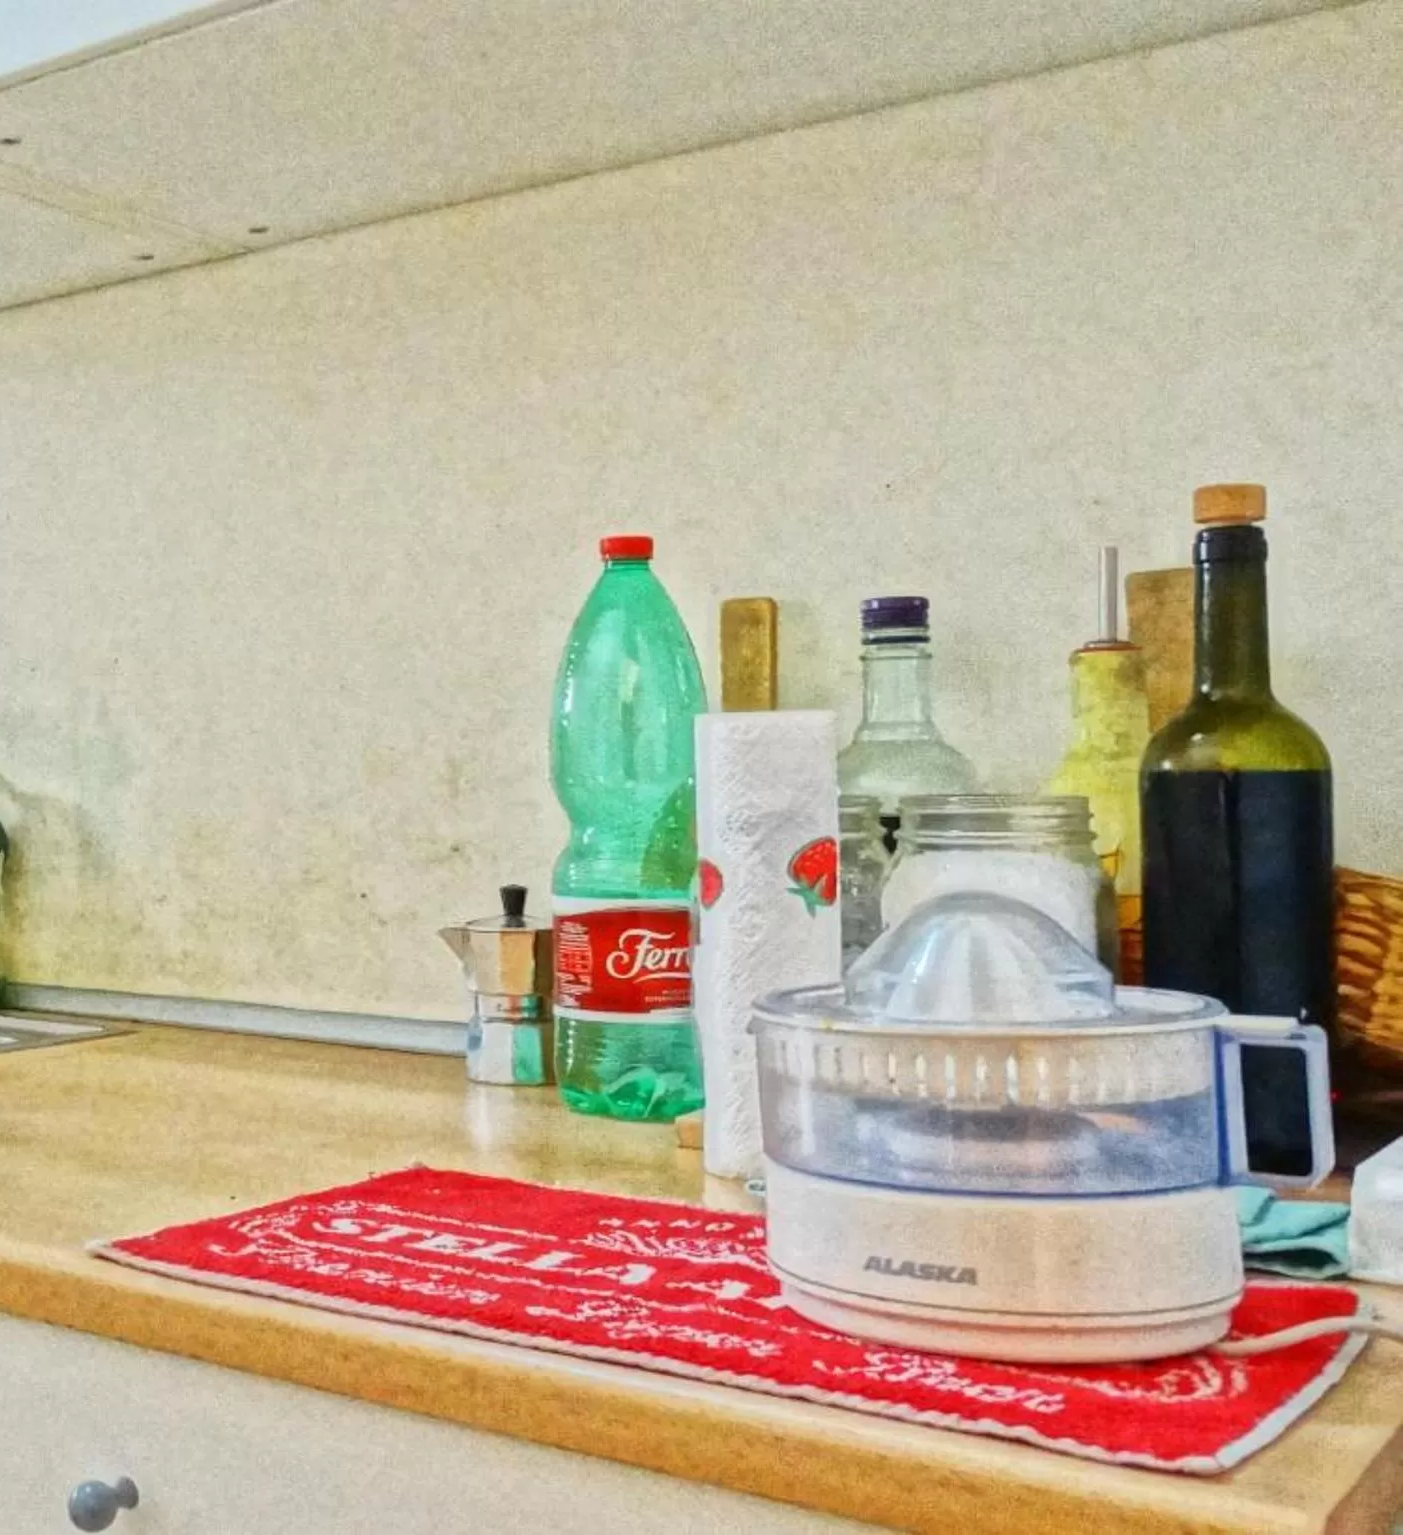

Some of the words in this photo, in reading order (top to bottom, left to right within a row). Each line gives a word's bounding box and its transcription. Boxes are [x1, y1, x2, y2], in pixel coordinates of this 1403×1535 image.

[605, 928, 692, 979] Ferr
[312, 1217, 656, 1286] STELLA
[862, 1255, 977, 1286] ALASKA
